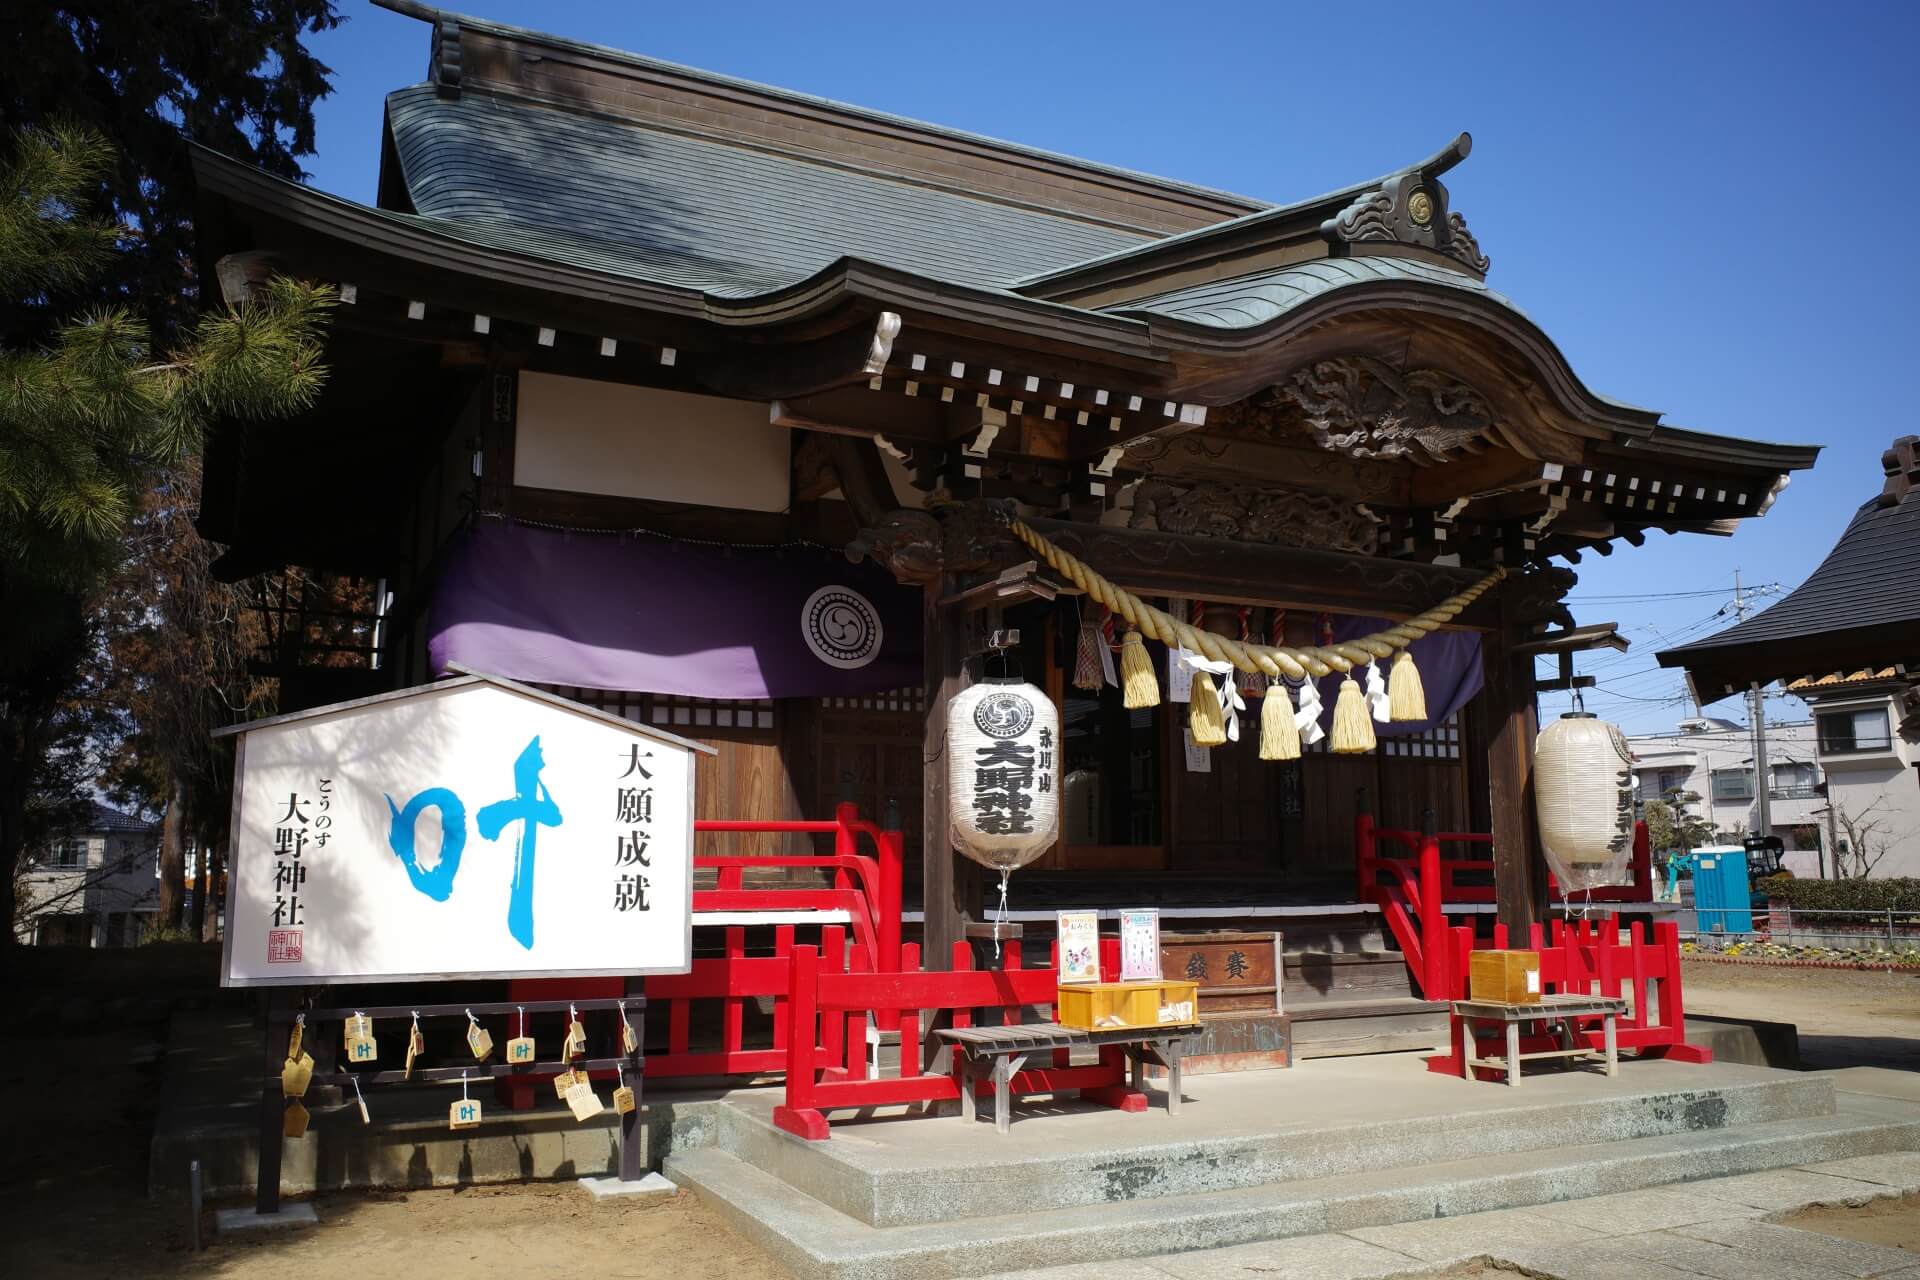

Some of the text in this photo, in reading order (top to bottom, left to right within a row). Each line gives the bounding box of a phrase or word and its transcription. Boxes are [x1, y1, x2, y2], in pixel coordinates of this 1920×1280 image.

[315, 778, 333, 849] こうのす
[613, 743, 655, 912] 大願成就
[972, 741, 1035, 835] 大野神社
[270, 793, 311, 928] 大野神社
[385, 734, 563, 951] 叶
[357, 1042, 371, 1059] 叶
[515, 1043, 531, 1059] 叶
[460, 1104, 476, 1121] 叶
